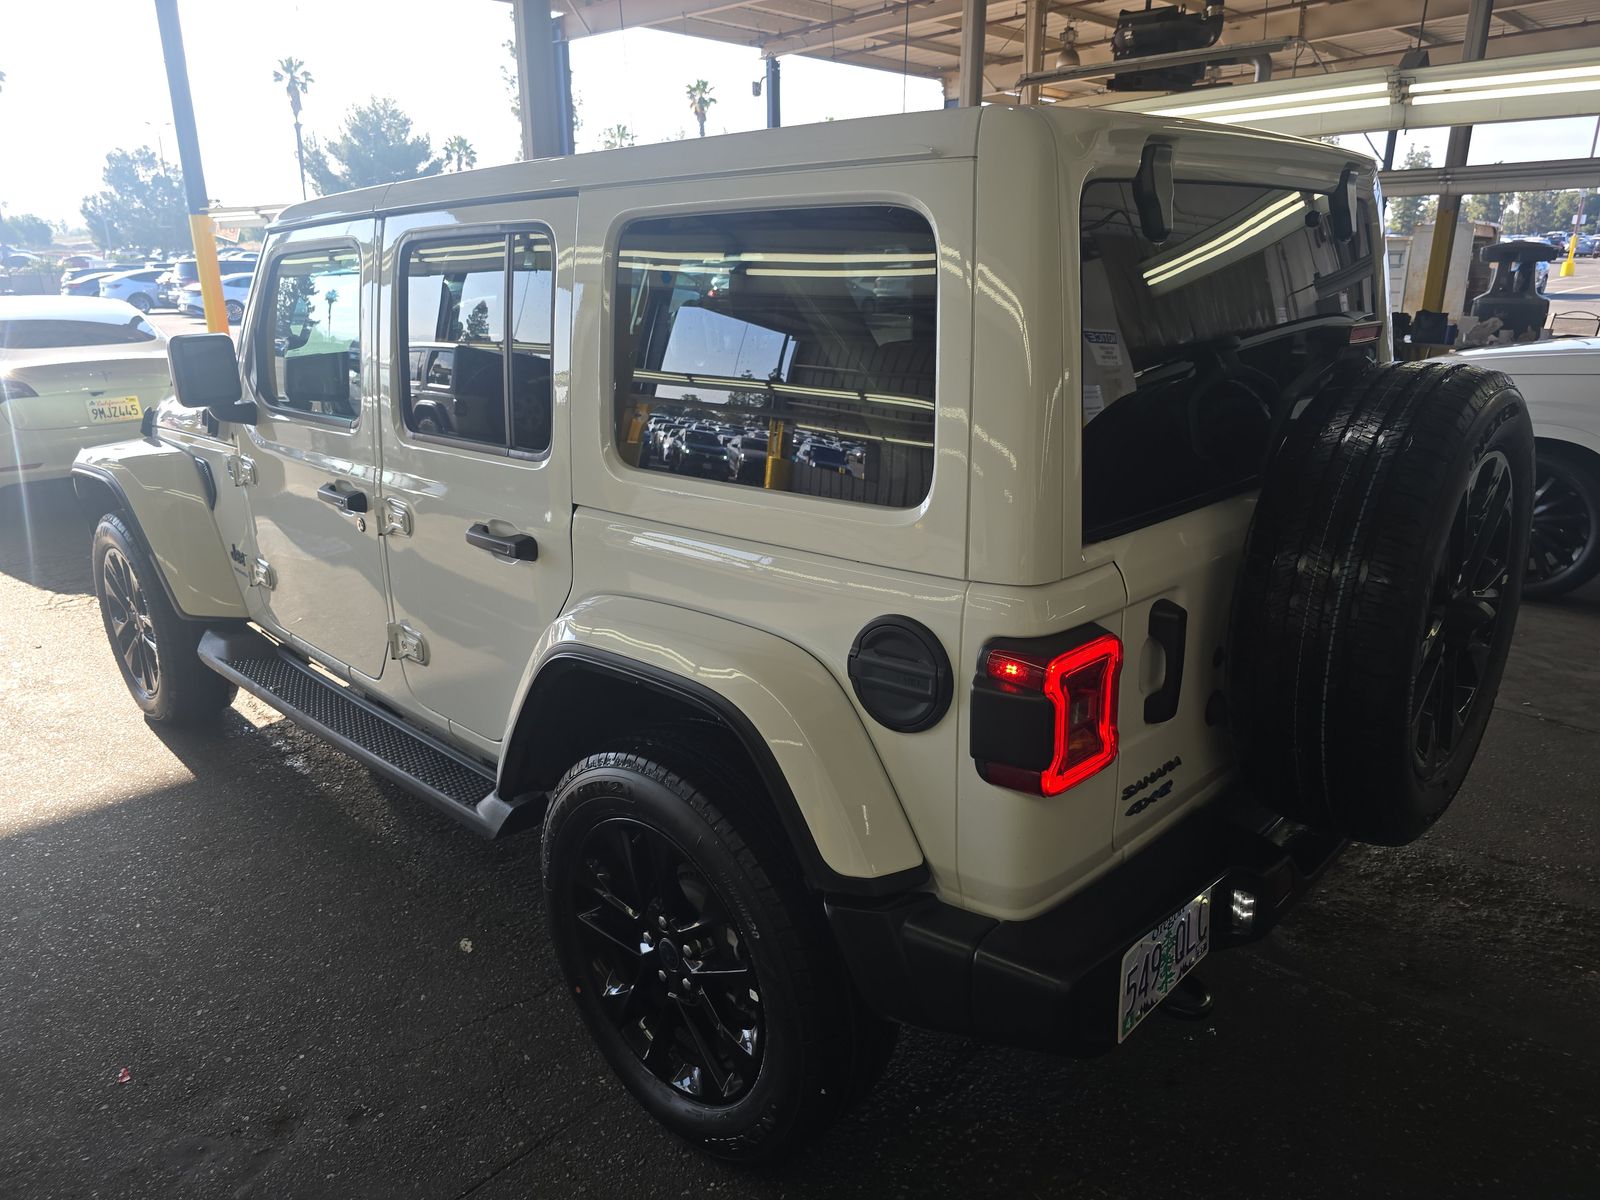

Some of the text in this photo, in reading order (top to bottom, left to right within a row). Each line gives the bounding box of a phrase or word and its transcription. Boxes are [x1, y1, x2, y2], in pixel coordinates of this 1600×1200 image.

[91, 405, 138, 420] 9MJZ445
[1121, 755, 1182, 801] SAHARA
[1126, 943, 1162, 1017] 549
